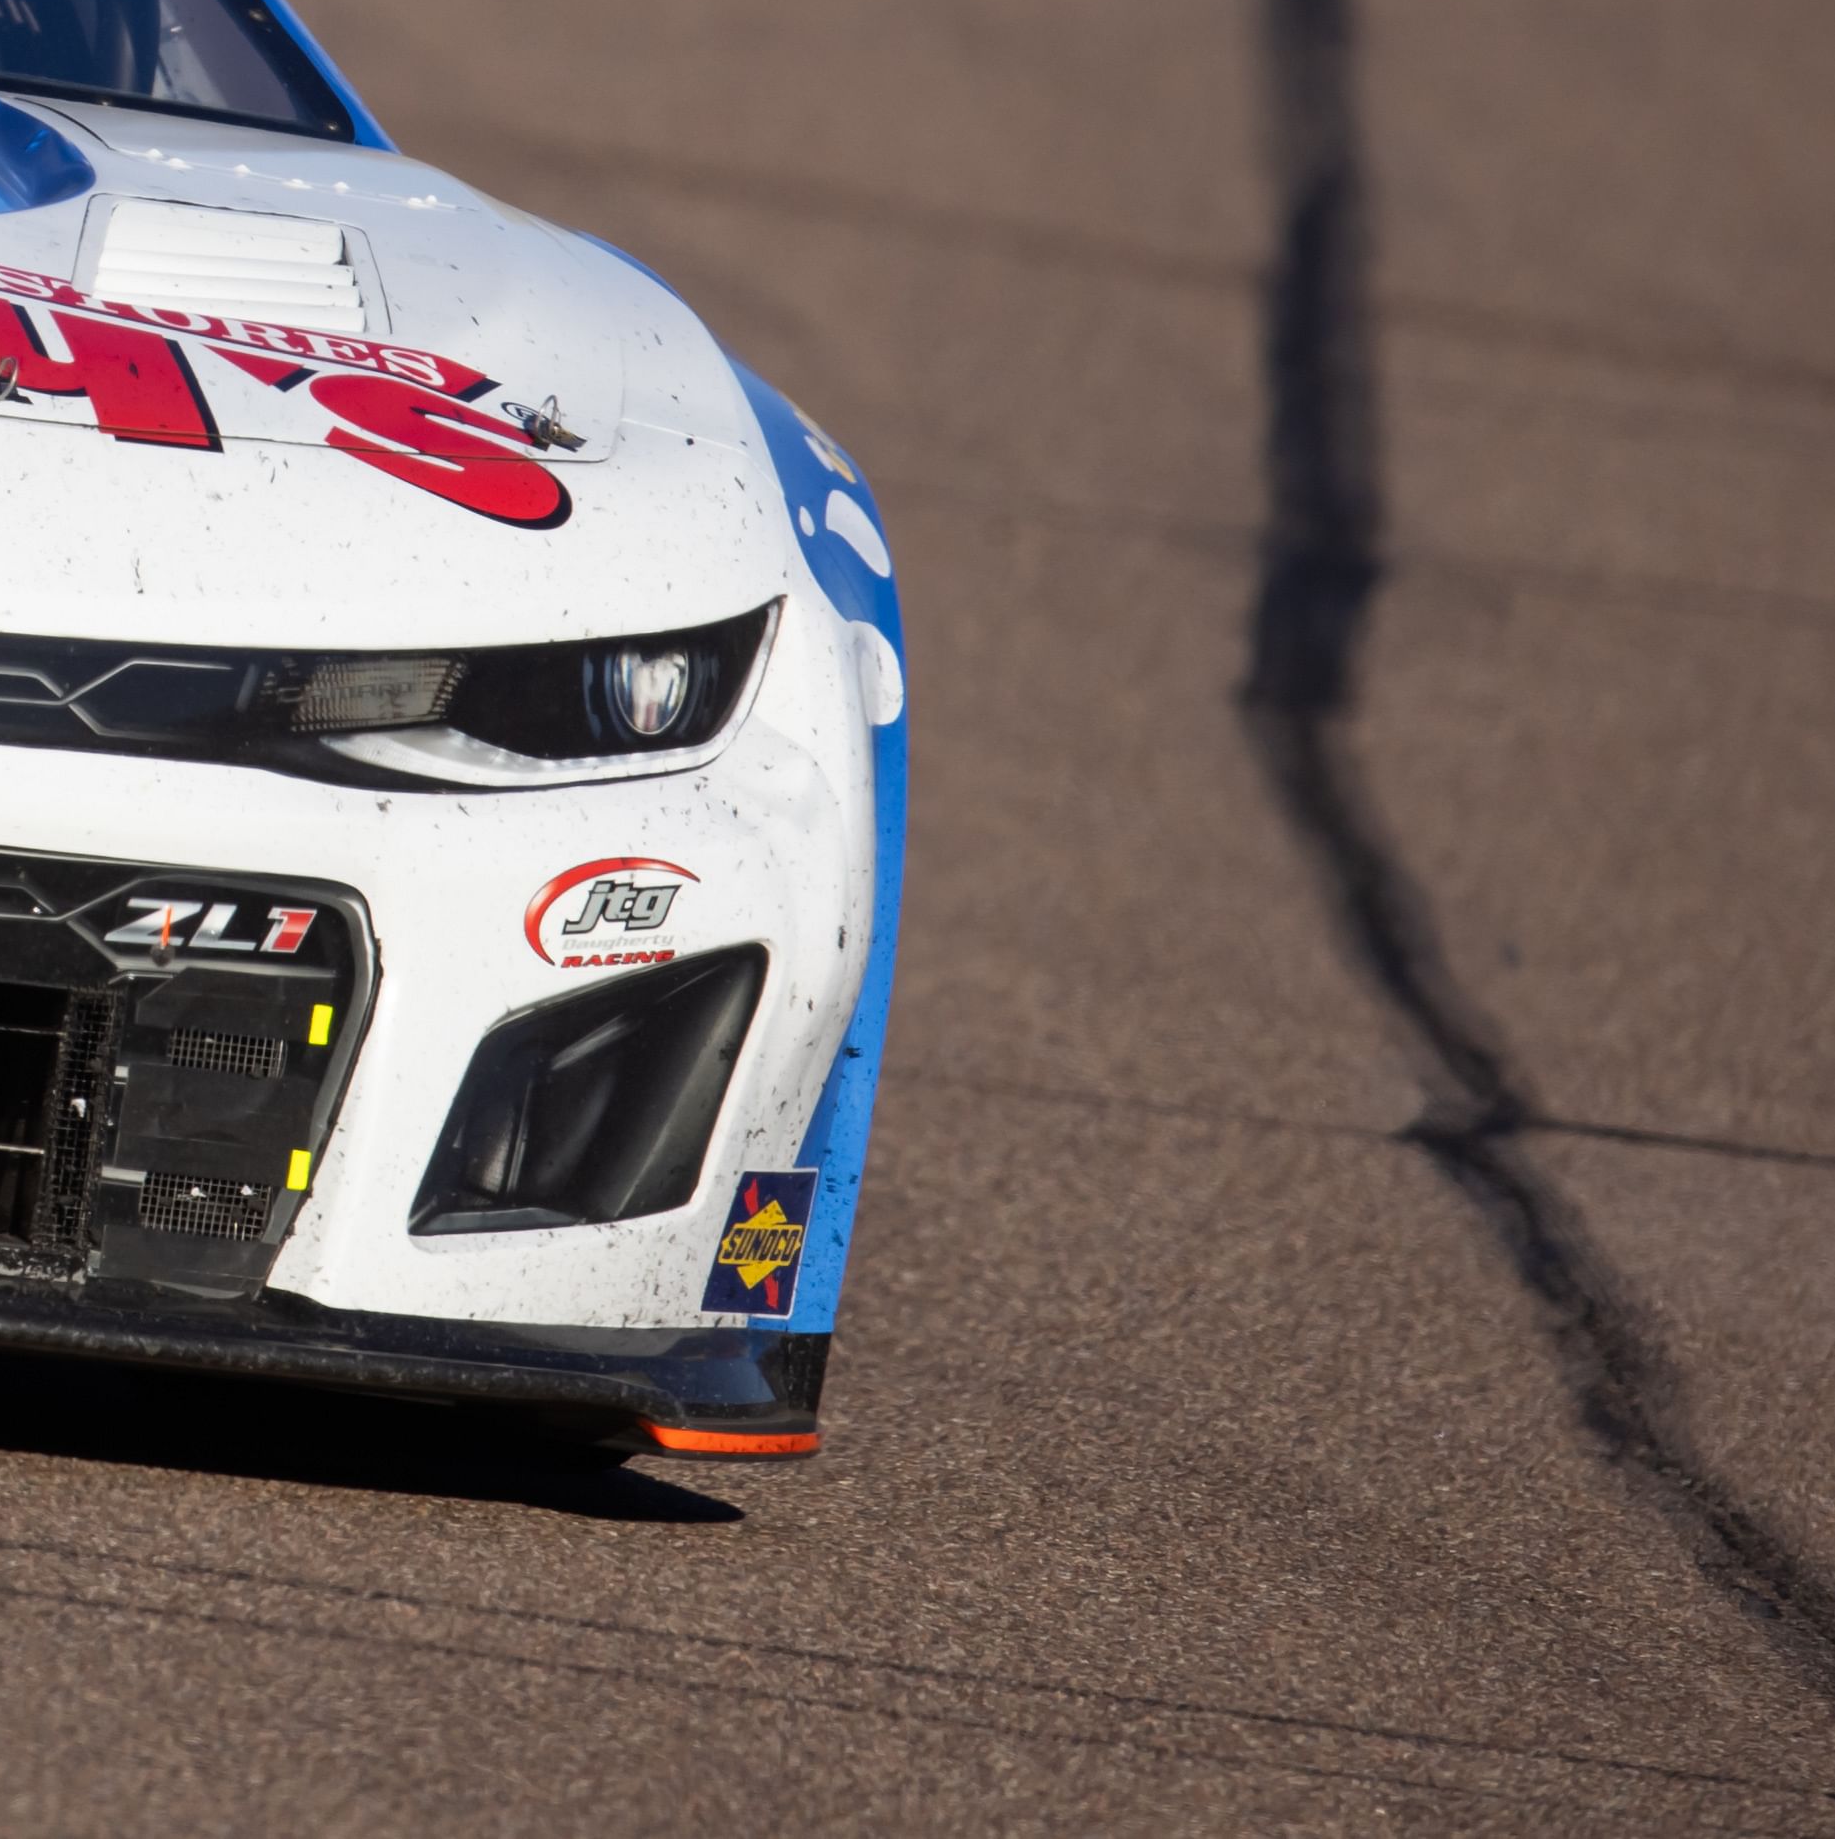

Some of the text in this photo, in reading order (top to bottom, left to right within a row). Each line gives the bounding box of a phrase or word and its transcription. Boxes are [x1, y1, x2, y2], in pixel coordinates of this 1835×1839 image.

[103, 897, 318, 953] ZL1
[561, 880, 683, 935] jtg
[561, 933, 675, 952] Daugherty
[561, 949, 676, 968] RACING
[721, 1227, 801, 1263] SUNOCO
